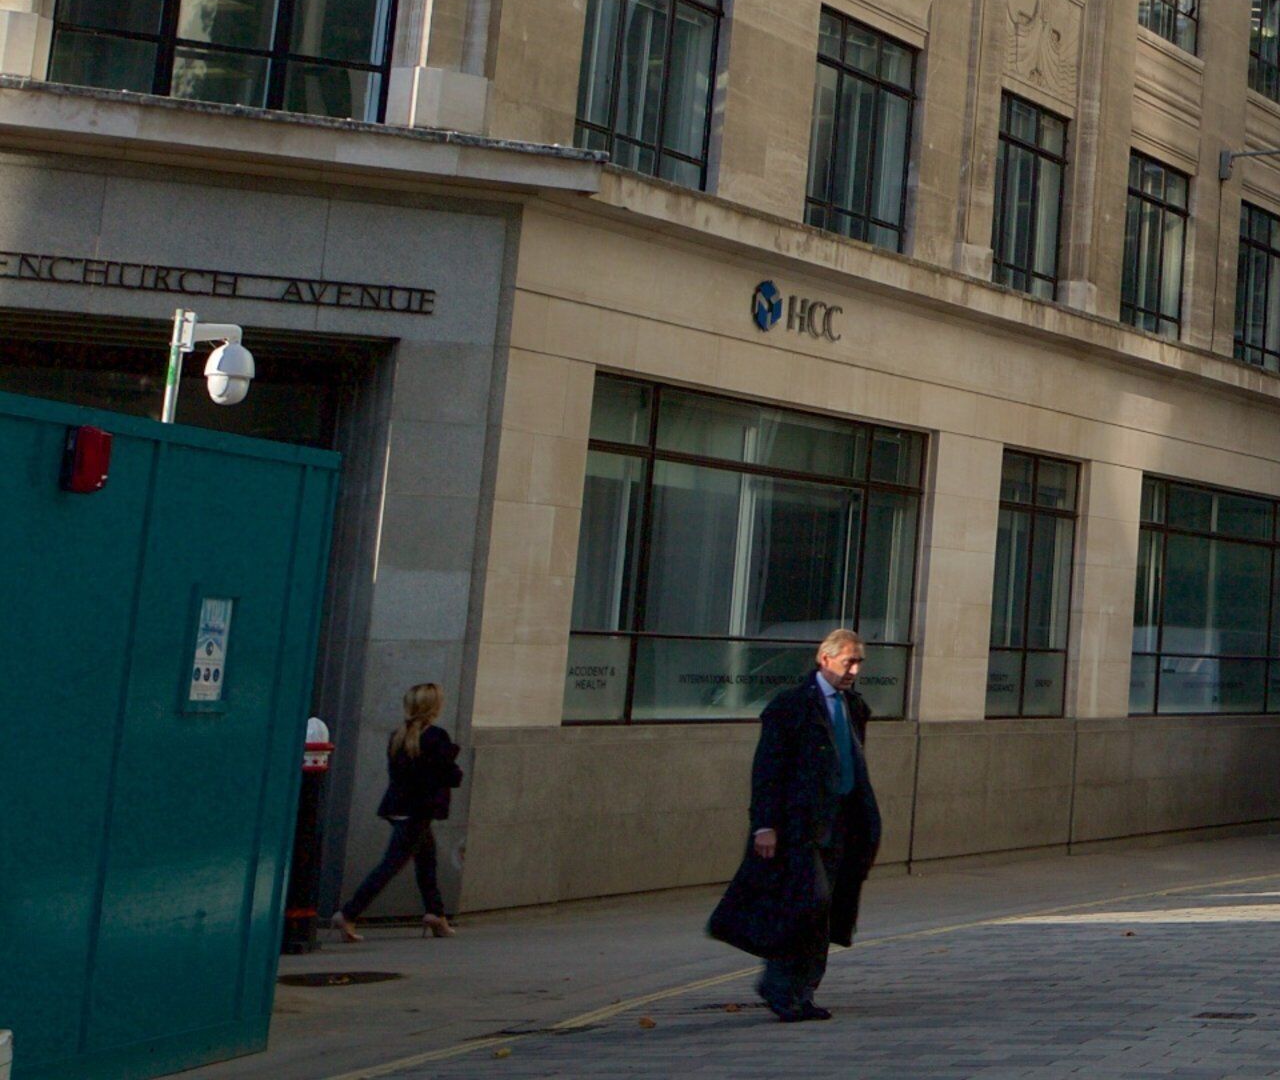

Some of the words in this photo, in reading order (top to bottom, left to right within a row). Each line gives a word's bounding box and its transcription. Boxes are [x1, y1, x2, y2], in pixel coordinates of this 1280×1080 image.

[281, 279, 436, 314] AVENUE
[786, 294, 843, 341] HCC
[568, 666, 609, 677] ACCIDENT
[575, 679, 607, 690] HEALTH
